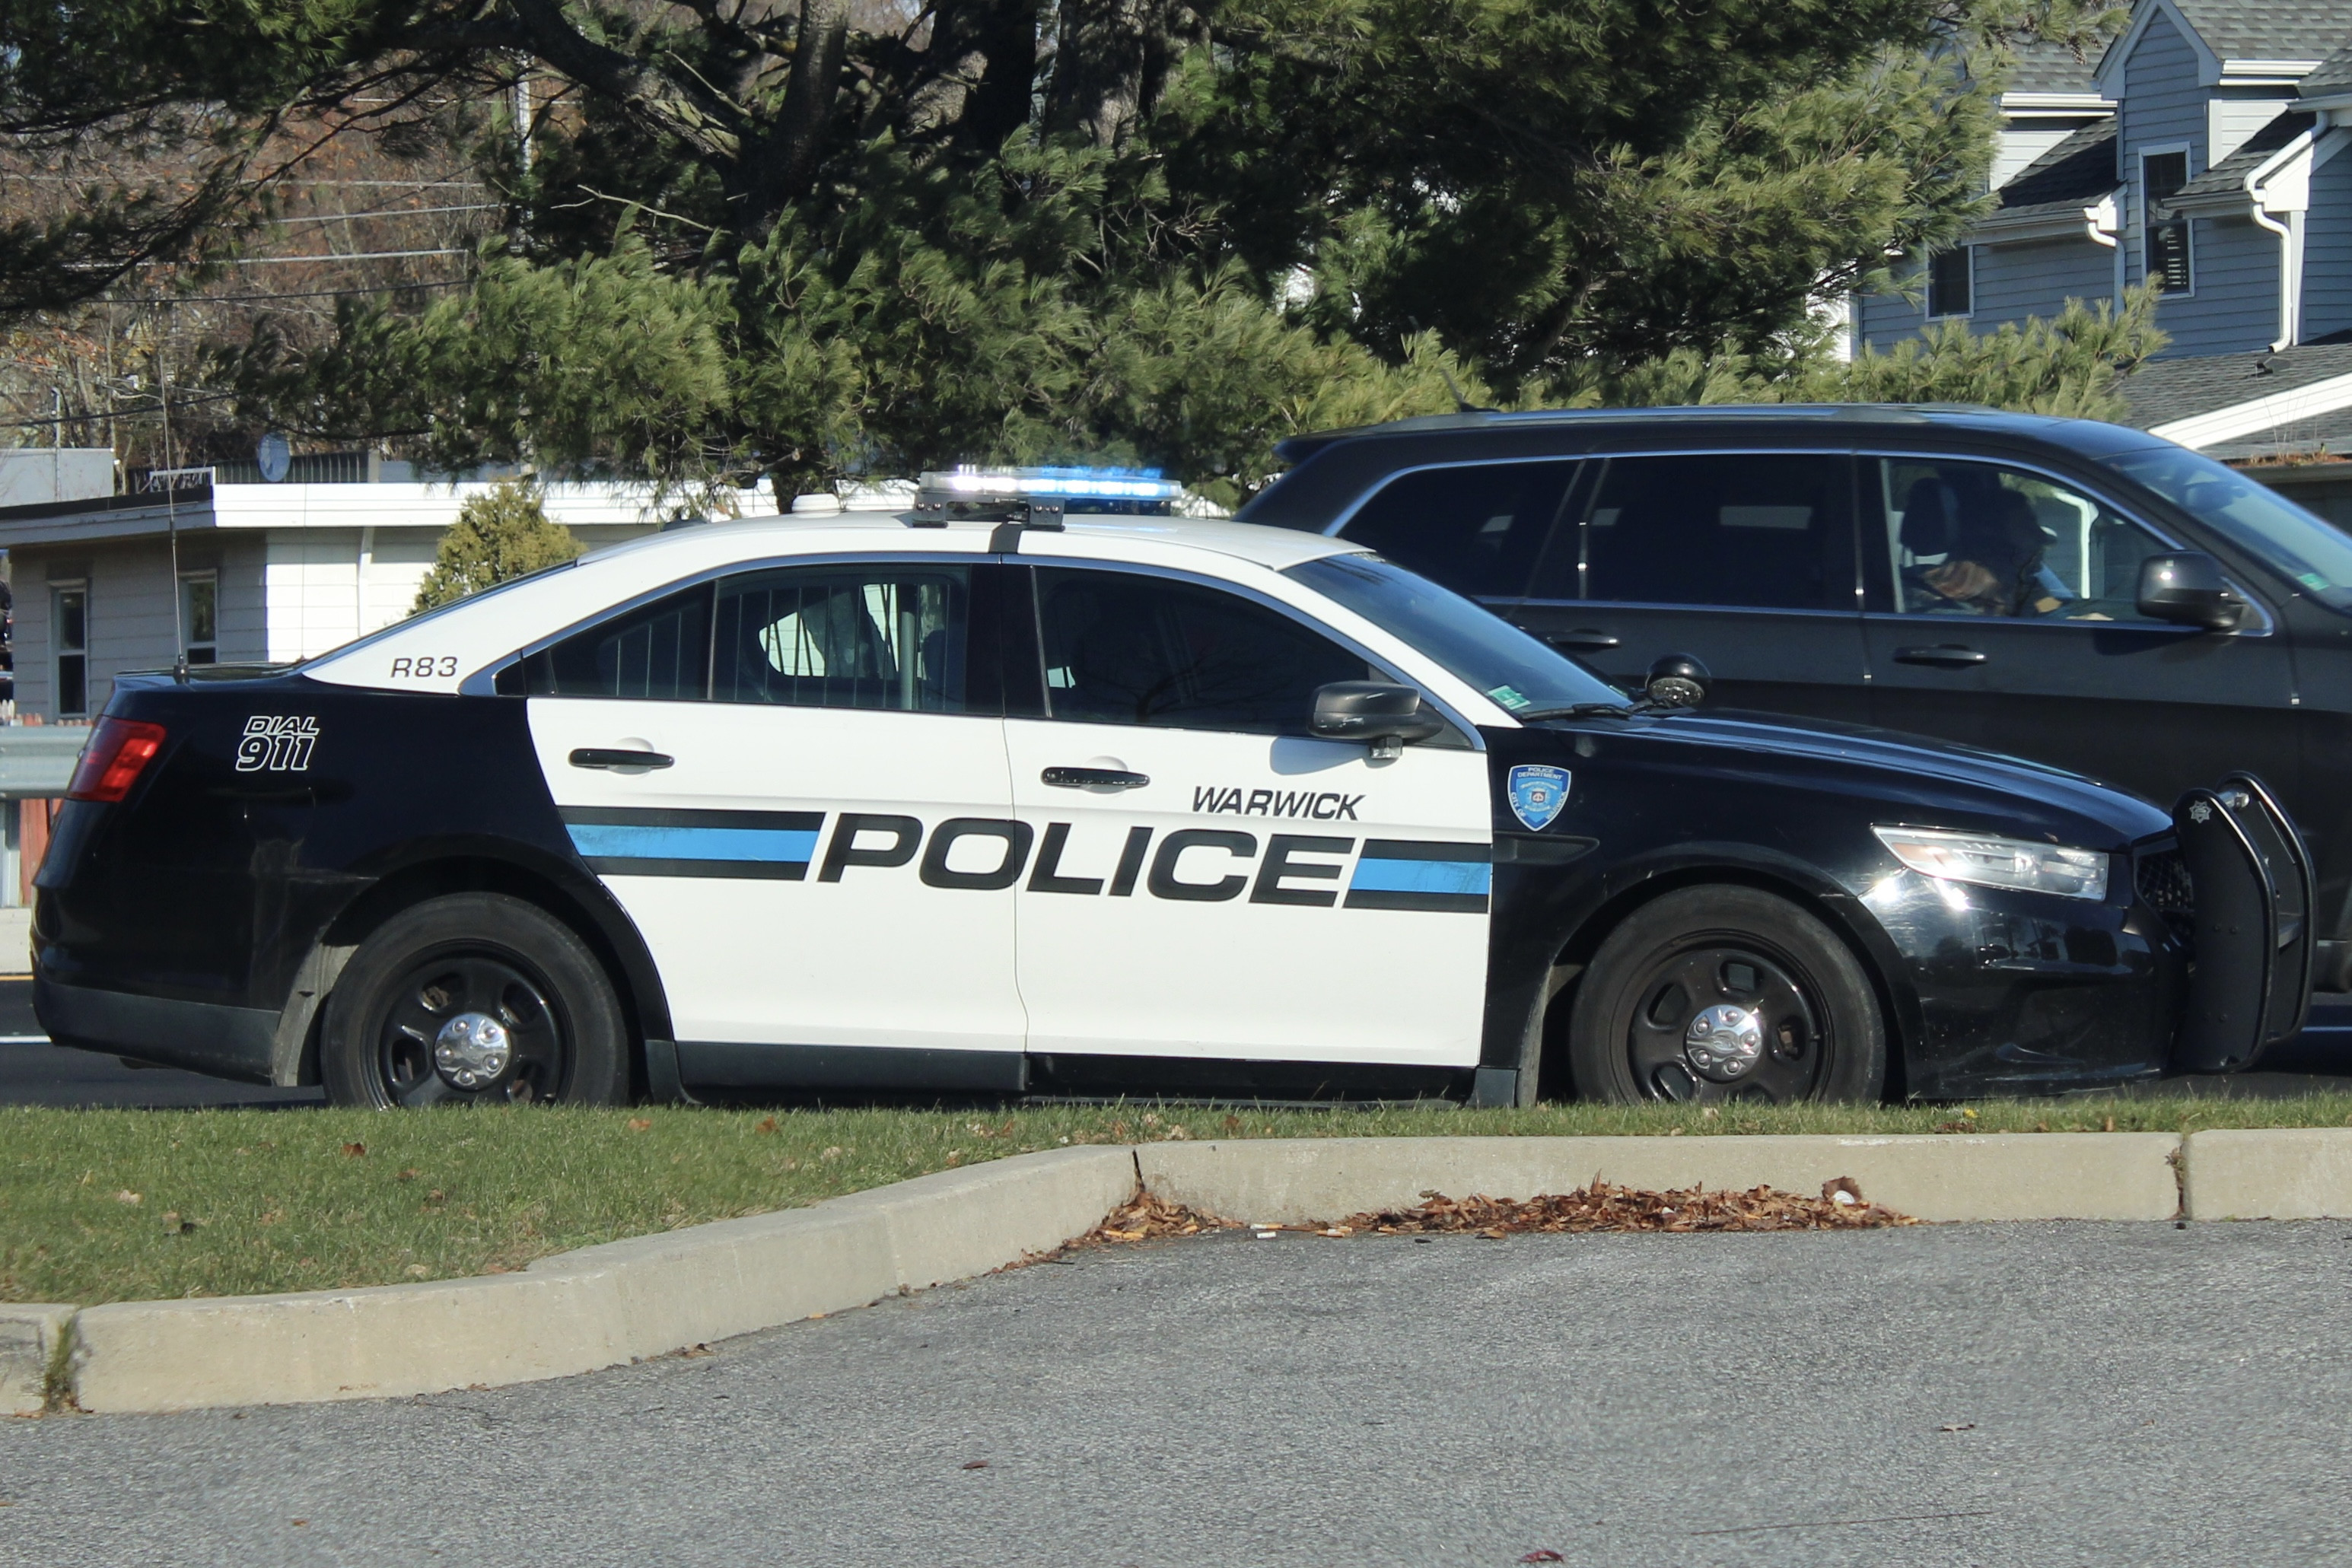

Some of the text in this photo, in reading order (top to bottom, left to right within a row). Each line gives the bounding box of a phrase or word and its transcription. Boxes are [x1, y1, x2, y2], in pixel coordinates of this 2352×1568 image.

[390, 656, 458, 678] R83
[243, 716, 320, 736] DIAL
[235, 735, 316, 771] 911
[1517, 771, 1564, 780] DEPARTMENT
[1192, 786, 1367, 821] WARWICK
[1510, 792, 1520, 807] CITY
[816, 812, 1356, 908] POLICE
